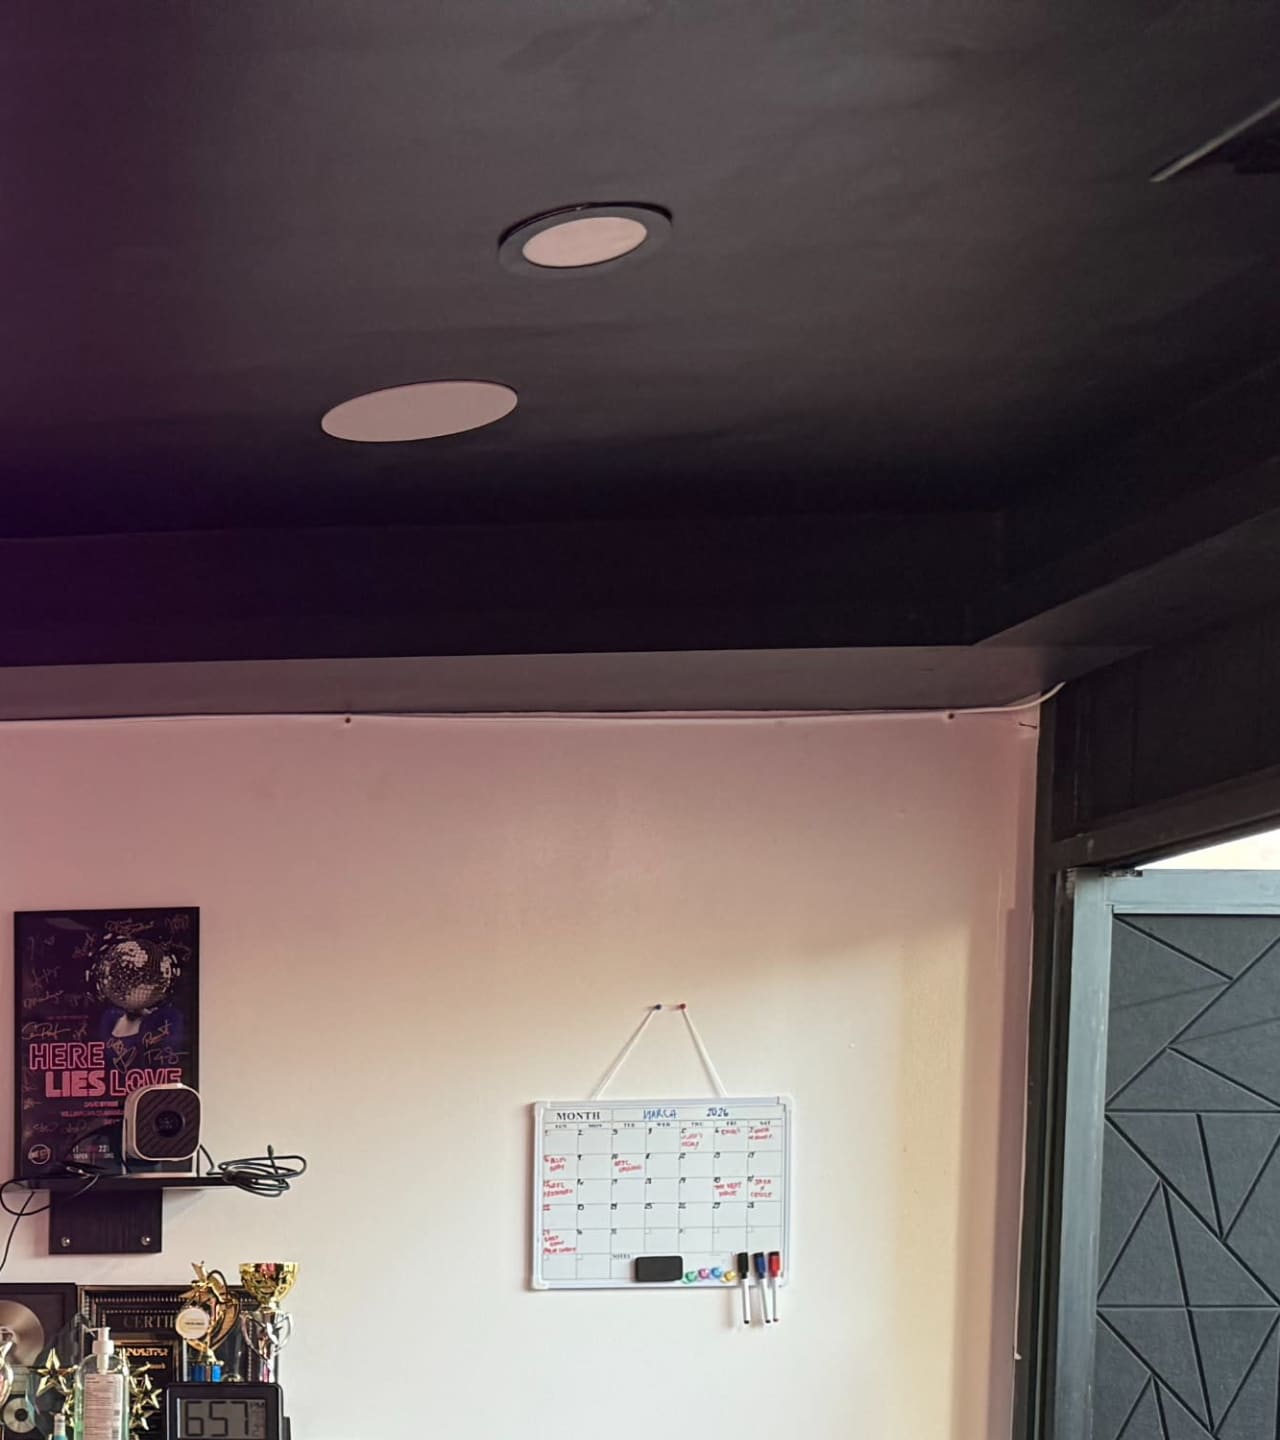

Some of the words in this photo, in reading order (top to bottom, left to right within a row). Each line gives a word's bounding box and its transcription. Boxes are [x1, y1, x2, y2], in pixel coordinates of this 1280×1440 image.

[29, 1042, 105, 1070] HERE
[45, 1070, 106, 1098] LIES
[110, 1068, 182, 1096] LOVE
[556, 1112, 600, 1120] MONTH
[706, 1108, 729, 1117] 2026
